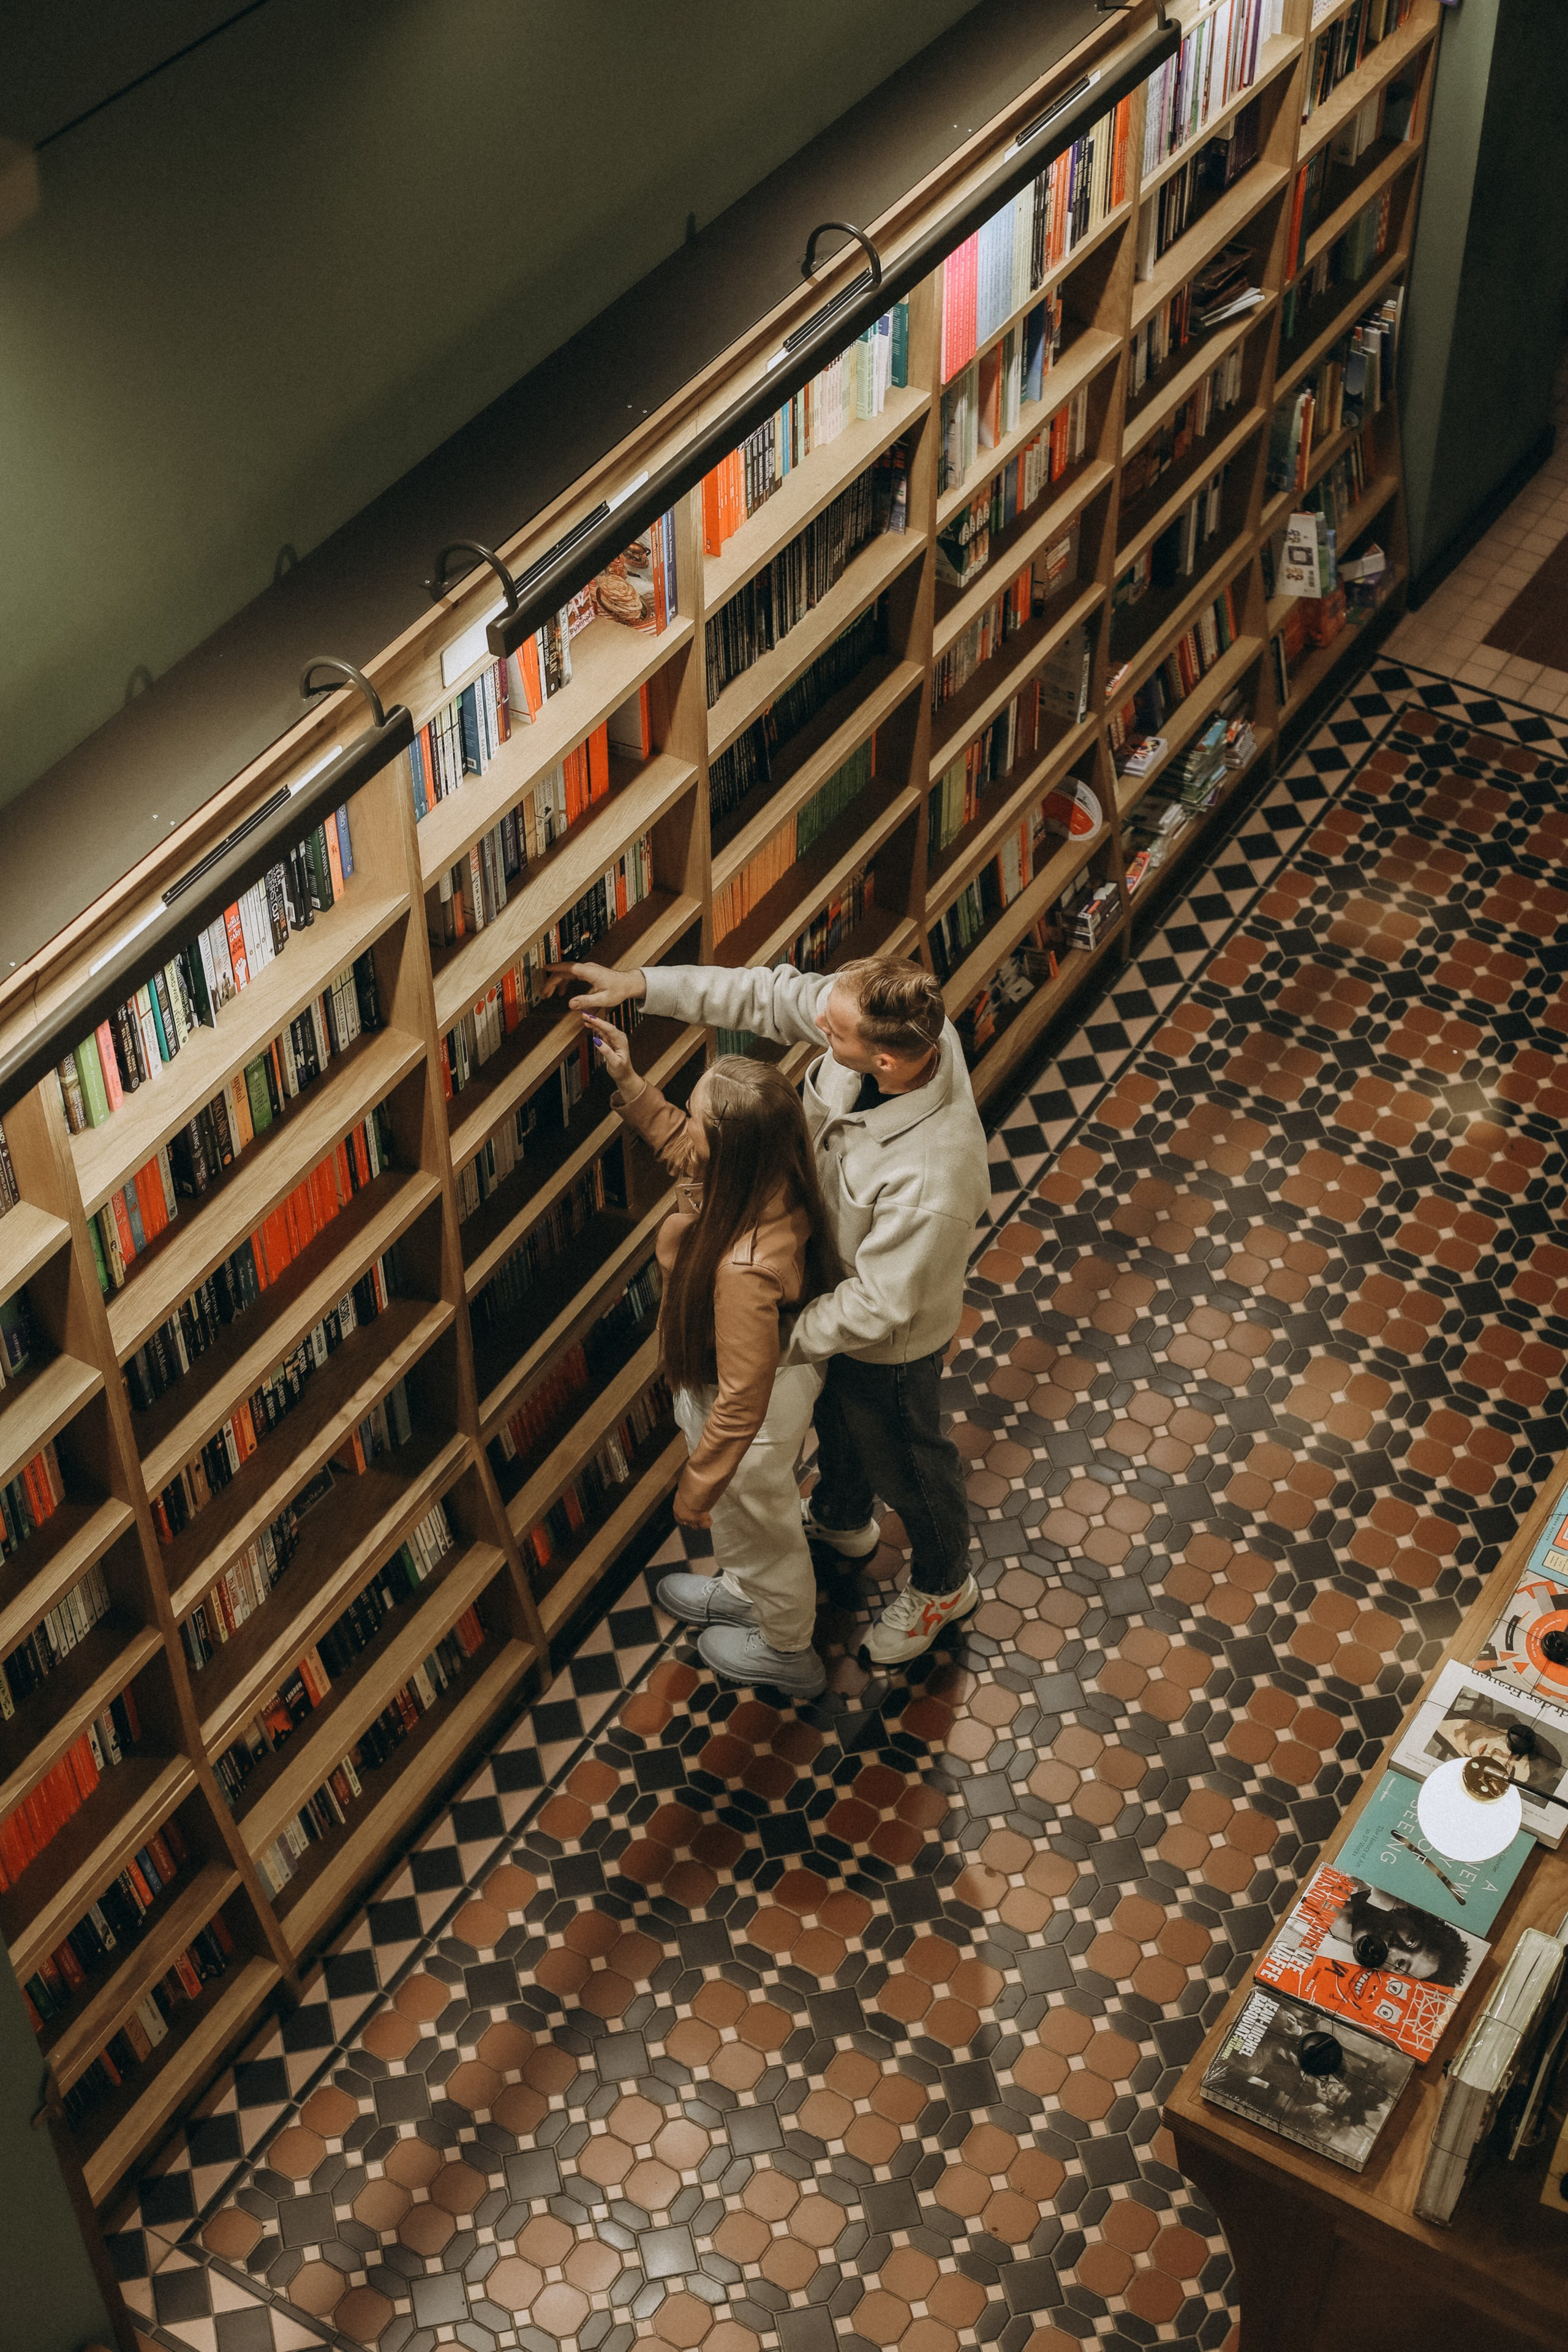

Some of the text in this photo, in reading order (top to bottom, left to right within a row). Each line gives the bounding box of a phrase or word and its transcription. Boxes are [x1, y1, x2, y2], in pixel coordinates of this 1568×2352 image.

[470, 860, 479, 874] SPY
[268, 878, 277, 903] FIRST
[227, 915, 239, 928] WORLD
[276, 893, 286, 929] ELSEWHERE
[228, 927, 241, 943] GARP
[205, 951, 215, 982] IRVING
[221, 939, 230, 970] IRVING
[124, 1022, 132, 1050] GUILLERMO
[173, 1009, 183, 1036] JEWELL
[230, 1076, 246, 1103] apital
[213, 1098, 228, 1145] RKDAWN
[337, 1295, 350, 1322] NESBO
[158, 1355, 169, 1381] MARTIN
[267, 1403, 276, 1419] NESBO
[1362, 1834, 1378, 1853] History
[1374, 1825, 1384, 1836] The
[1352, 1841, 1364, 1856] Works
[1355, 1859, 1364, 1868] Art
[1491, 1854, 1506, 1873] Grovier
[1294, 1866, 1340, 1925] BASQUIAT
[1480, 1879, 1501, 1896] A
[1298, 1874, 1356, 1954] JEAN-MICHEL
[1259, 1941, 1295, 1981] JAFFE
[1286, 1948, 1314, 1975] LEE
[1238, 1997, 1280, 2059] JEAN-MICHEL
